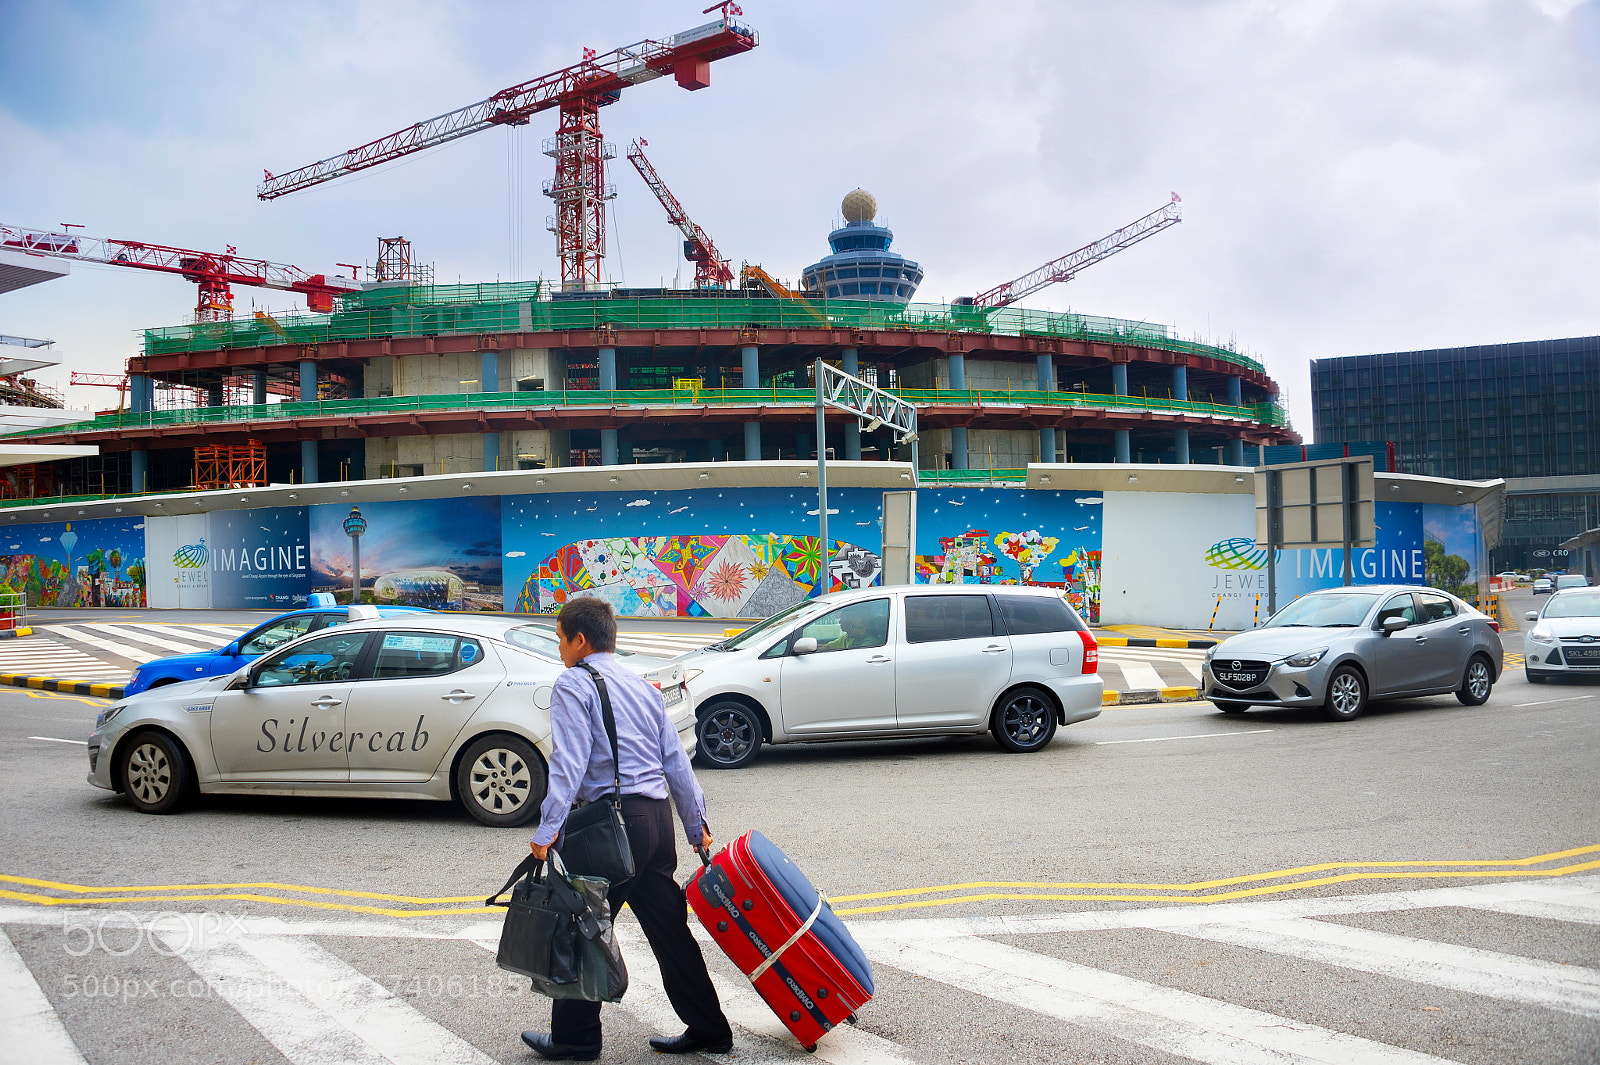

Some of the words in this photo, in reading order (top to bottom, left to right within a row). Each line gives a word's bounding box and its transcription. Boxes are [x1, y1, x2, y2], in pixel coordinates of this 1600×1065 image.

[213, 545, 306, 572] IMAGINE
[1552, 549, 1569, 557] CRO
[1296, 549, 1423, 579] IMAGINE
[176, 570, 208, 583] JEWEL
[1212, 574, 1277, 589] JEWE
[256, 714, 430, 753] Silvercab
